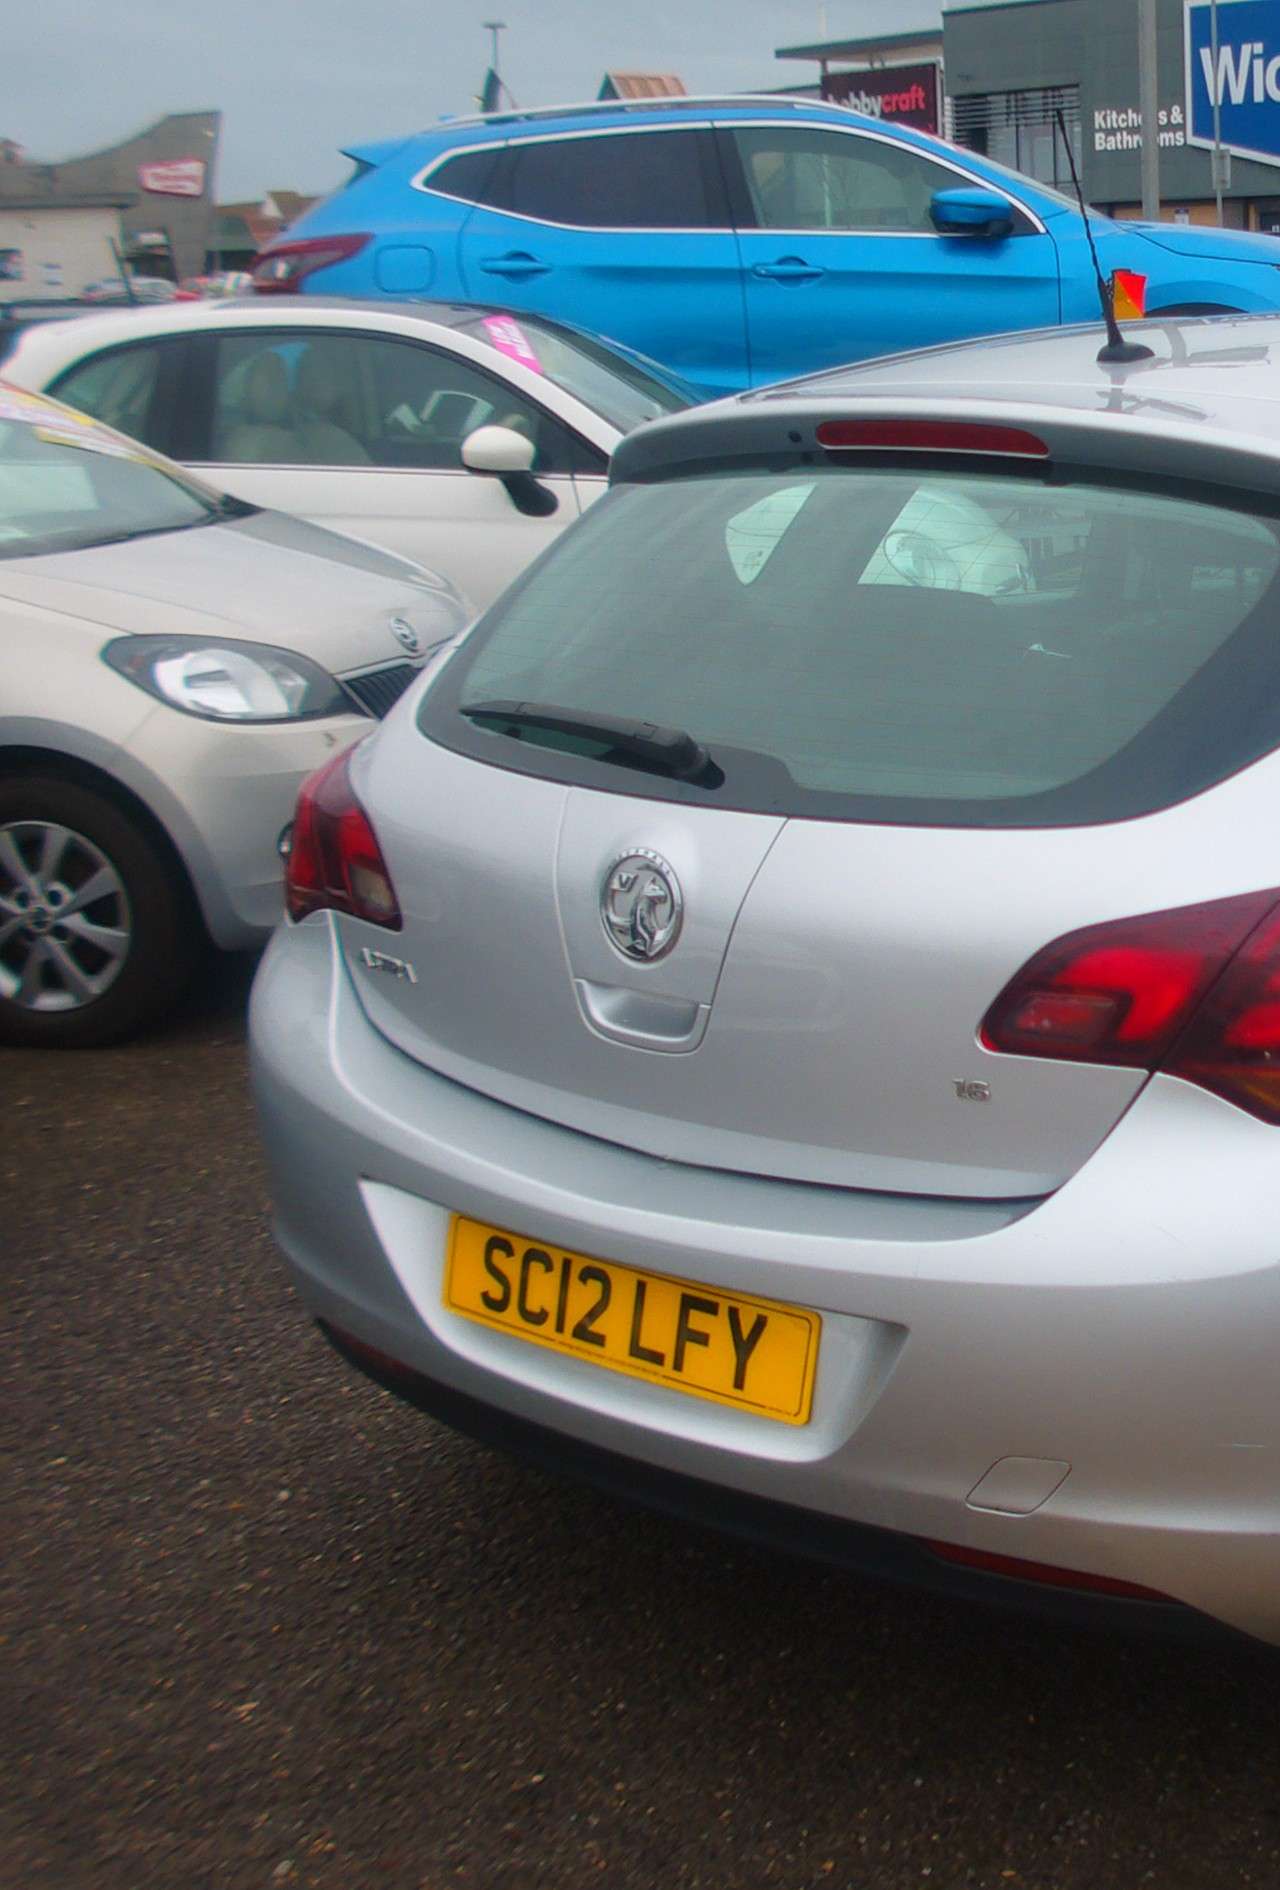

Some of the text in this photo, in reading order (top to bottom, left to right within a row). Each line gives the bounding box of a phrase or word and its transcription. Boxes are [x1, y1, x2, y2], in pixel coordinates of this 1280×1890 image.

[828, 84, 926, 119] bbycraft
[1094, 105, 1184, 129] Kitchs &
[1094, 131, 1184, 151] Bathrms
[480, 1235, 769, 1391] SC12 LFY
